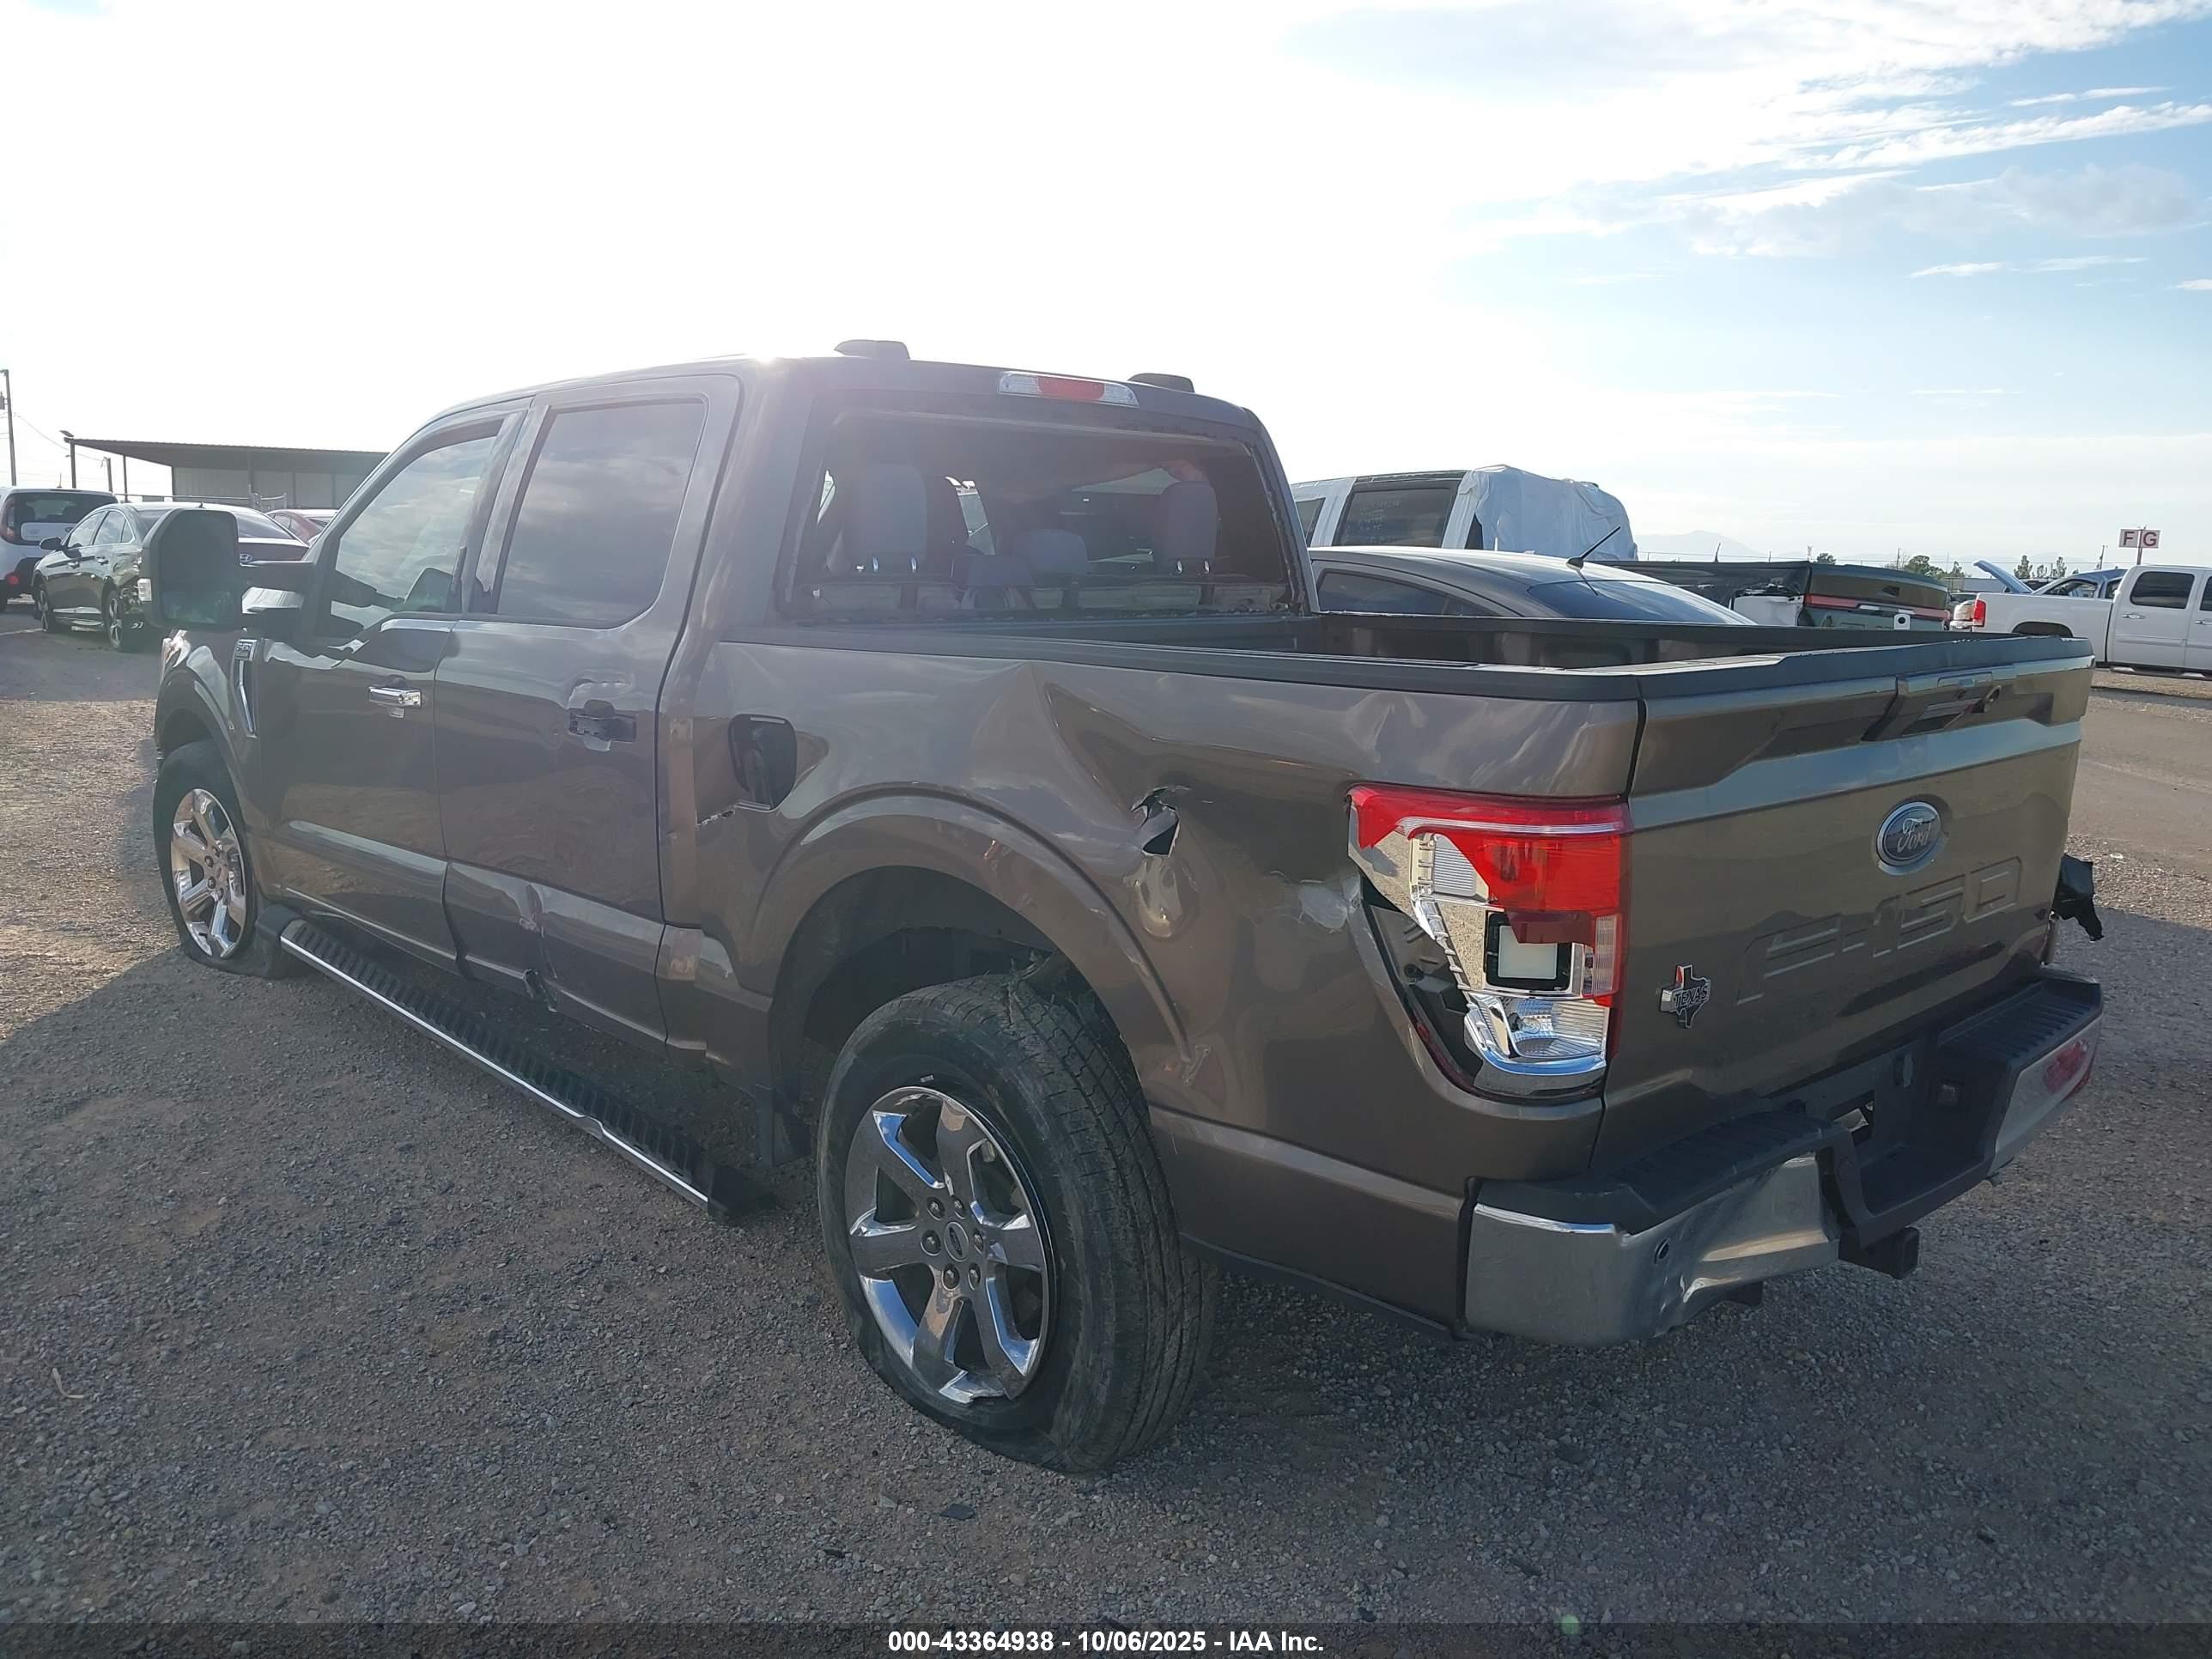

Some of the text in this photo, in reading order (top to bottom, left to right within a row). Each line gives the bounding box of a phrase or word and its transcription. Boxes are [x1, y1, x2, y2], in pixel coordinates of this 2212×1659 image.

[1897, 817, 1931, 853] Ford
[1736, 856, 2022, 1005] F-150
[1674, 985, 1708, 1008] TEXAS
